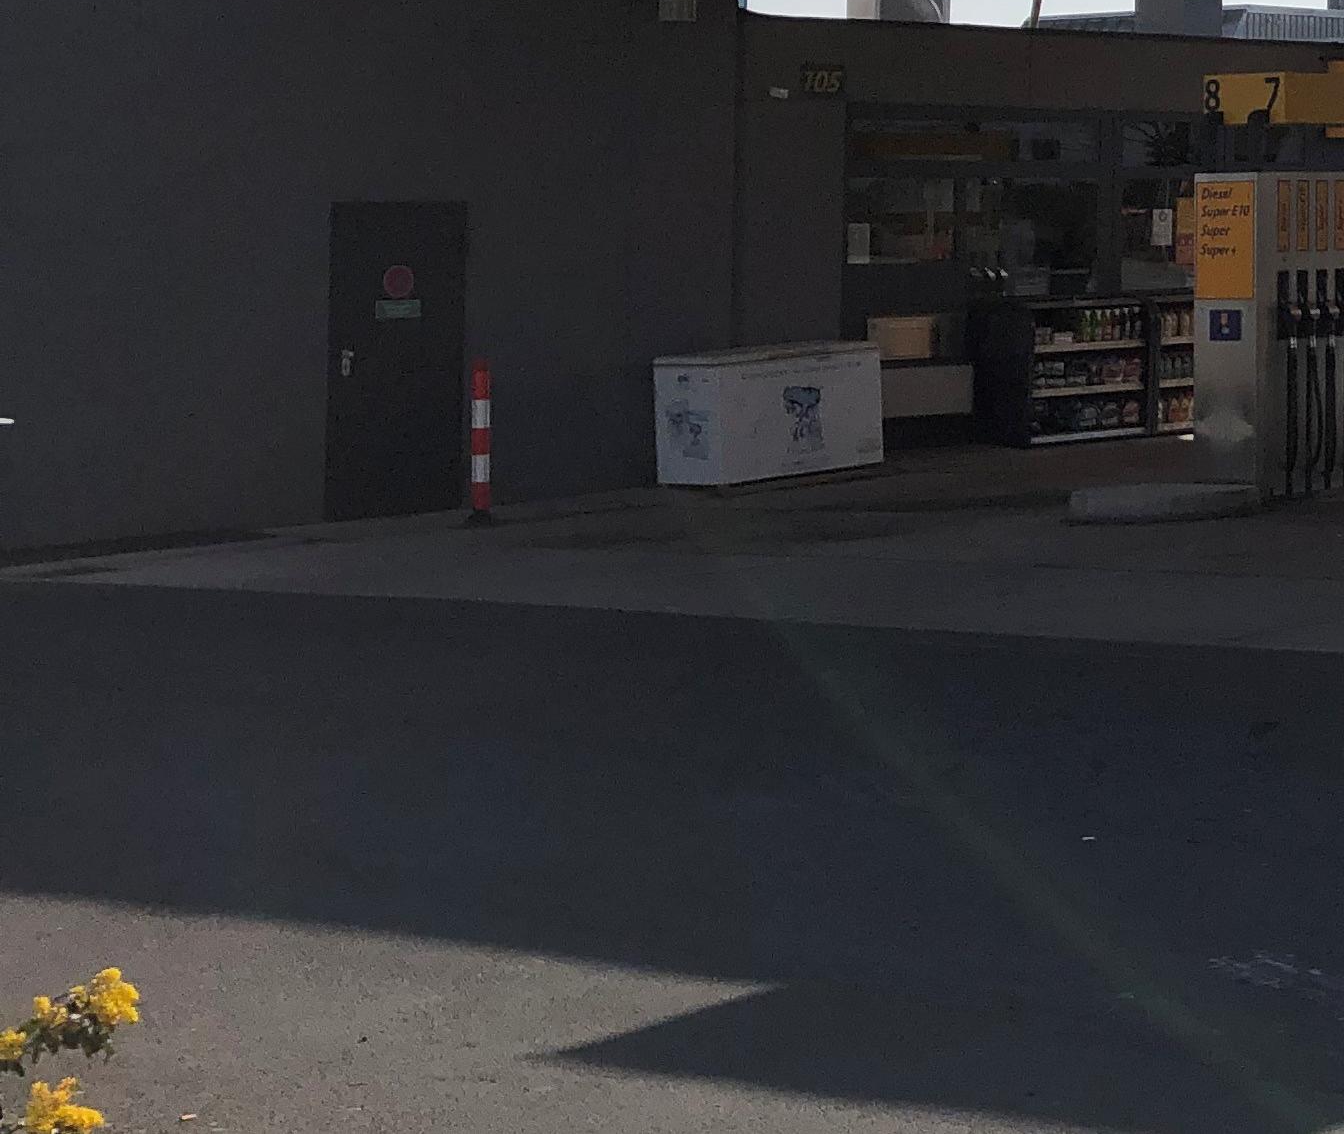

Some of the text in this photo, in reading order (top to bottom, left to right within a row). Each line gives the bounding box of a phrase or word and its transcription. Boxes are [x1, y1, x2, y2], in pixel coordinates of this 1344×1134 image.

[1205, 79, 1220, 111] 8
[1264, 77, 1280, 122] 7
[1201, 187, 1233, 201] Diesel
[1201, 205, 1231, 218] Super
[1200, 225, 1231, 240] Super
